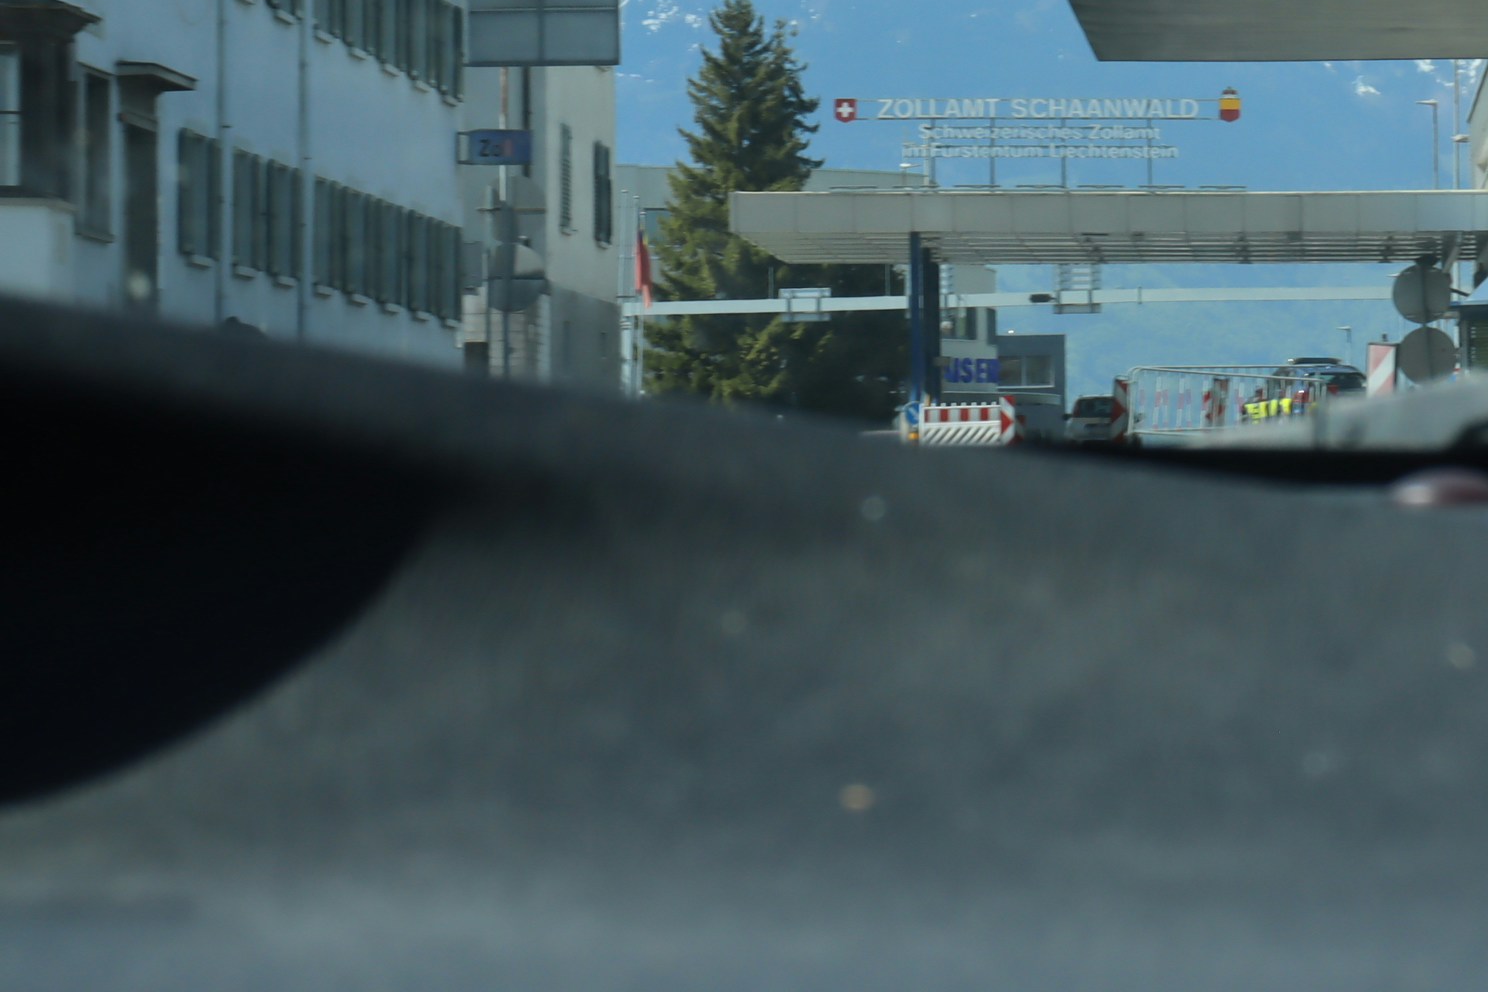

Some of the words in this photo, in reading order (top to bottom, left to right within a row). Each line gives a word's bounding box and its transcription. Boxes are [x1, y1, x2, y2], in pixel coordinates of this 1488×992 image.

[877, 98, 1001, 118] ZOLLAMT
[1010, 98, 1200, 118] SCHAANWALD
[1087, 123, 1161, 139] Zollamt
